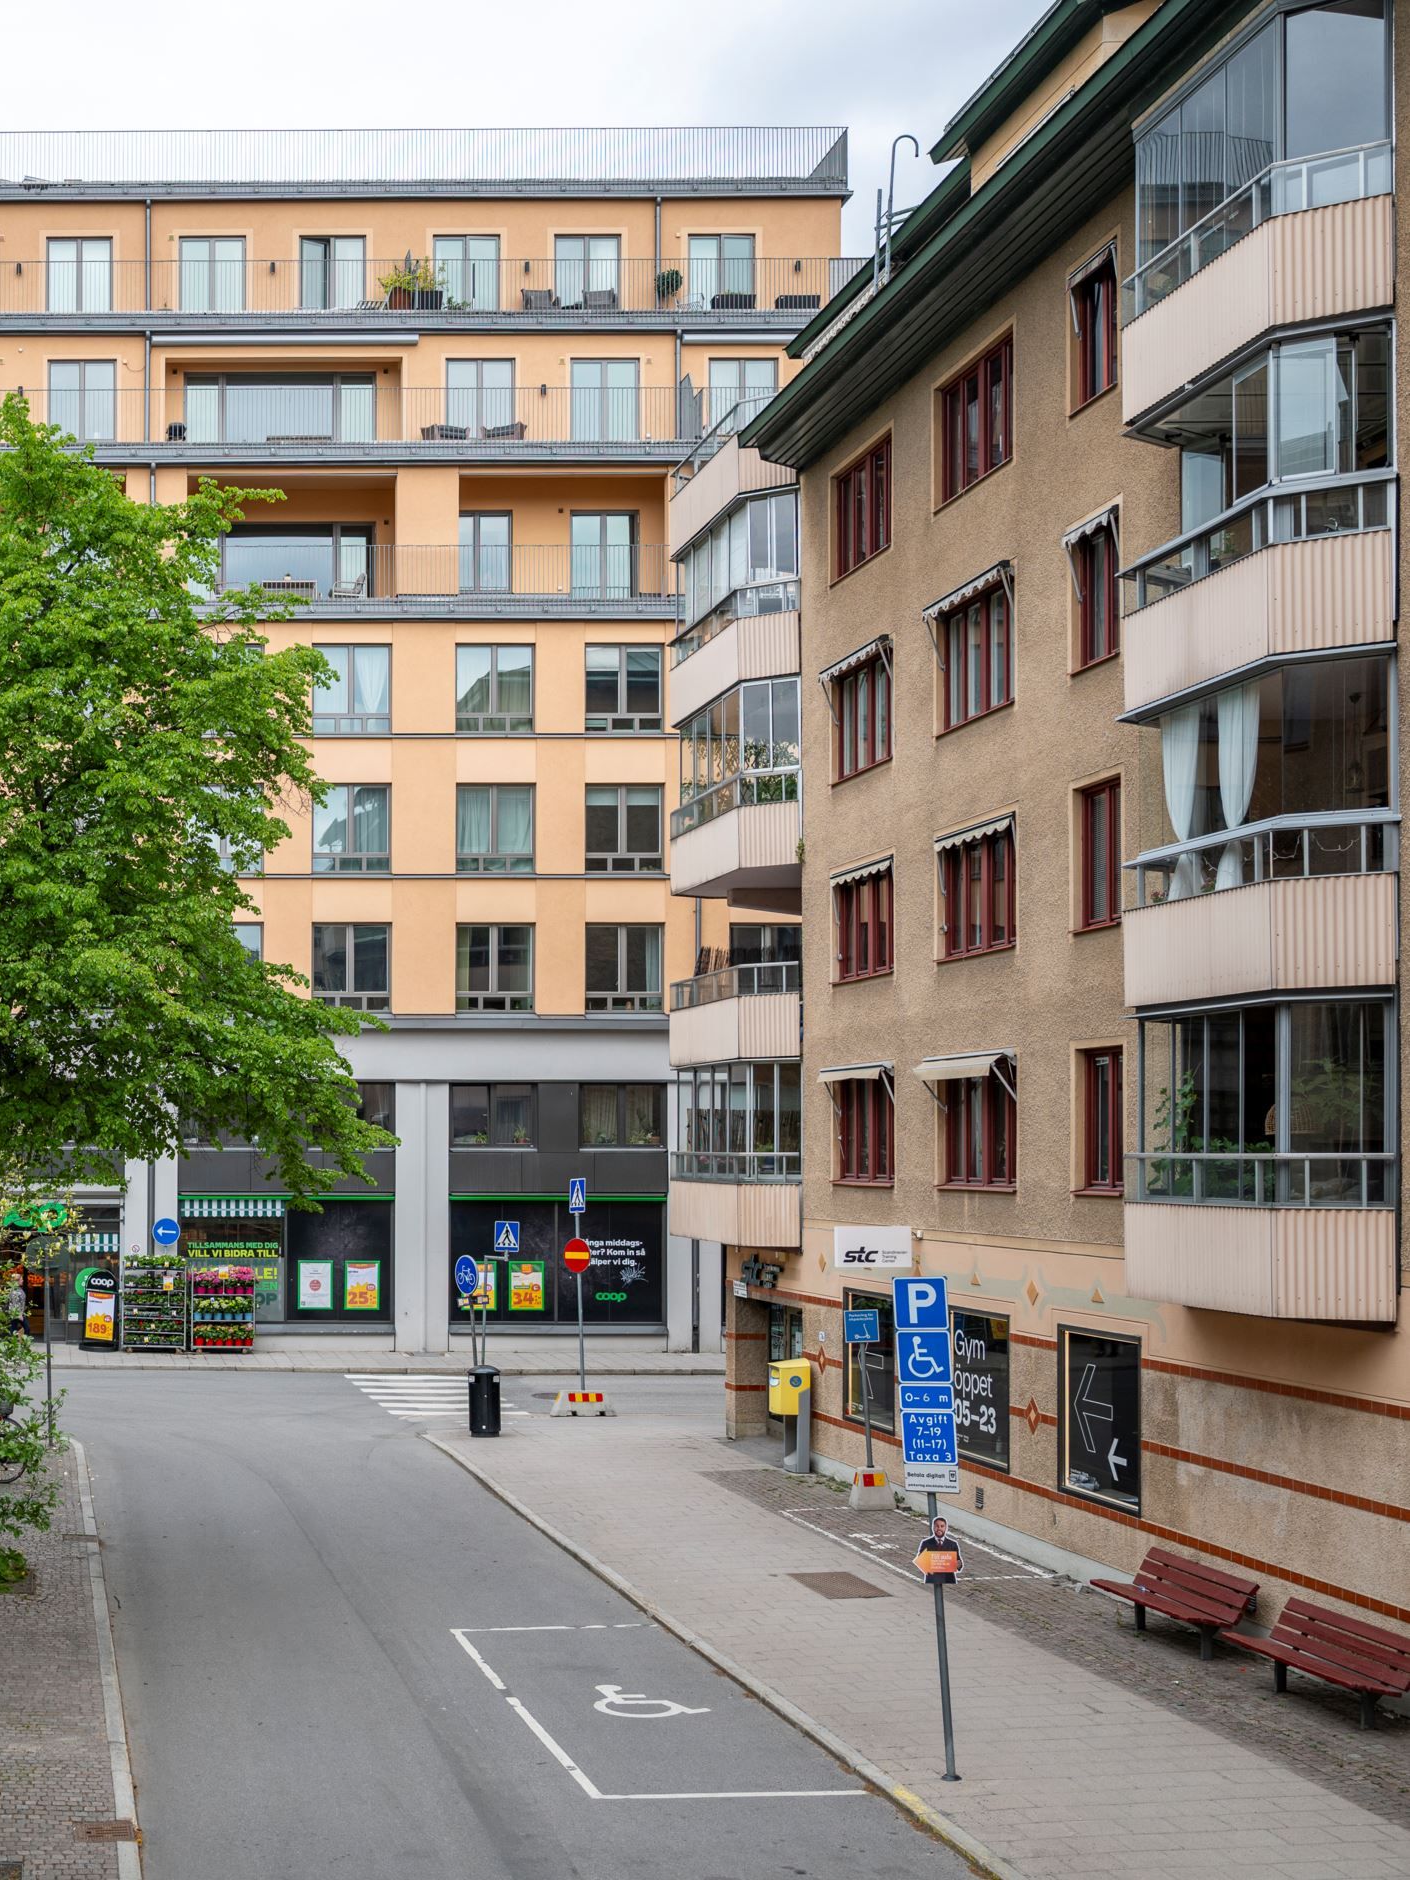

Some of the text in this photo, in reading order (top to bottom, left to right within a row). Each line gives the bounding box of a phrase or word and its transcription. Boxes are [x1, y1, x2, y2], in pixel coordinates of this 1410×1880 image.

[583, 1239, 604, 1247] ånga
[187, 1249, 278, 1257] VILL VI BIDRA TILL
[626, 1248, 634, 1256] in
[636, 1248, 645, 1256] så
[843, 1246, 878, 1263] stc
[589, 1258, 611, 1266] älper
[622, 1258, 637, 1267] dig.
[91, 1278, 114, 1288] coop
[595, 1292, 627, 1302] coop
[907, 1283, 937, 1324] P
[954, 1329, 986, 1364] Gym
[954, 1363, 993, 1400] öppet
[939, 1395, 948, 1403] m
[909, 1414, 948, 1425] Avgift
[955, 1398, 997, 1434] 05-23
[916, 1427, 941, 1436] 7-19
[912, 1438, 947, 1450] (11-17)
[909, 1451, 952, 1462] Taxa 3
